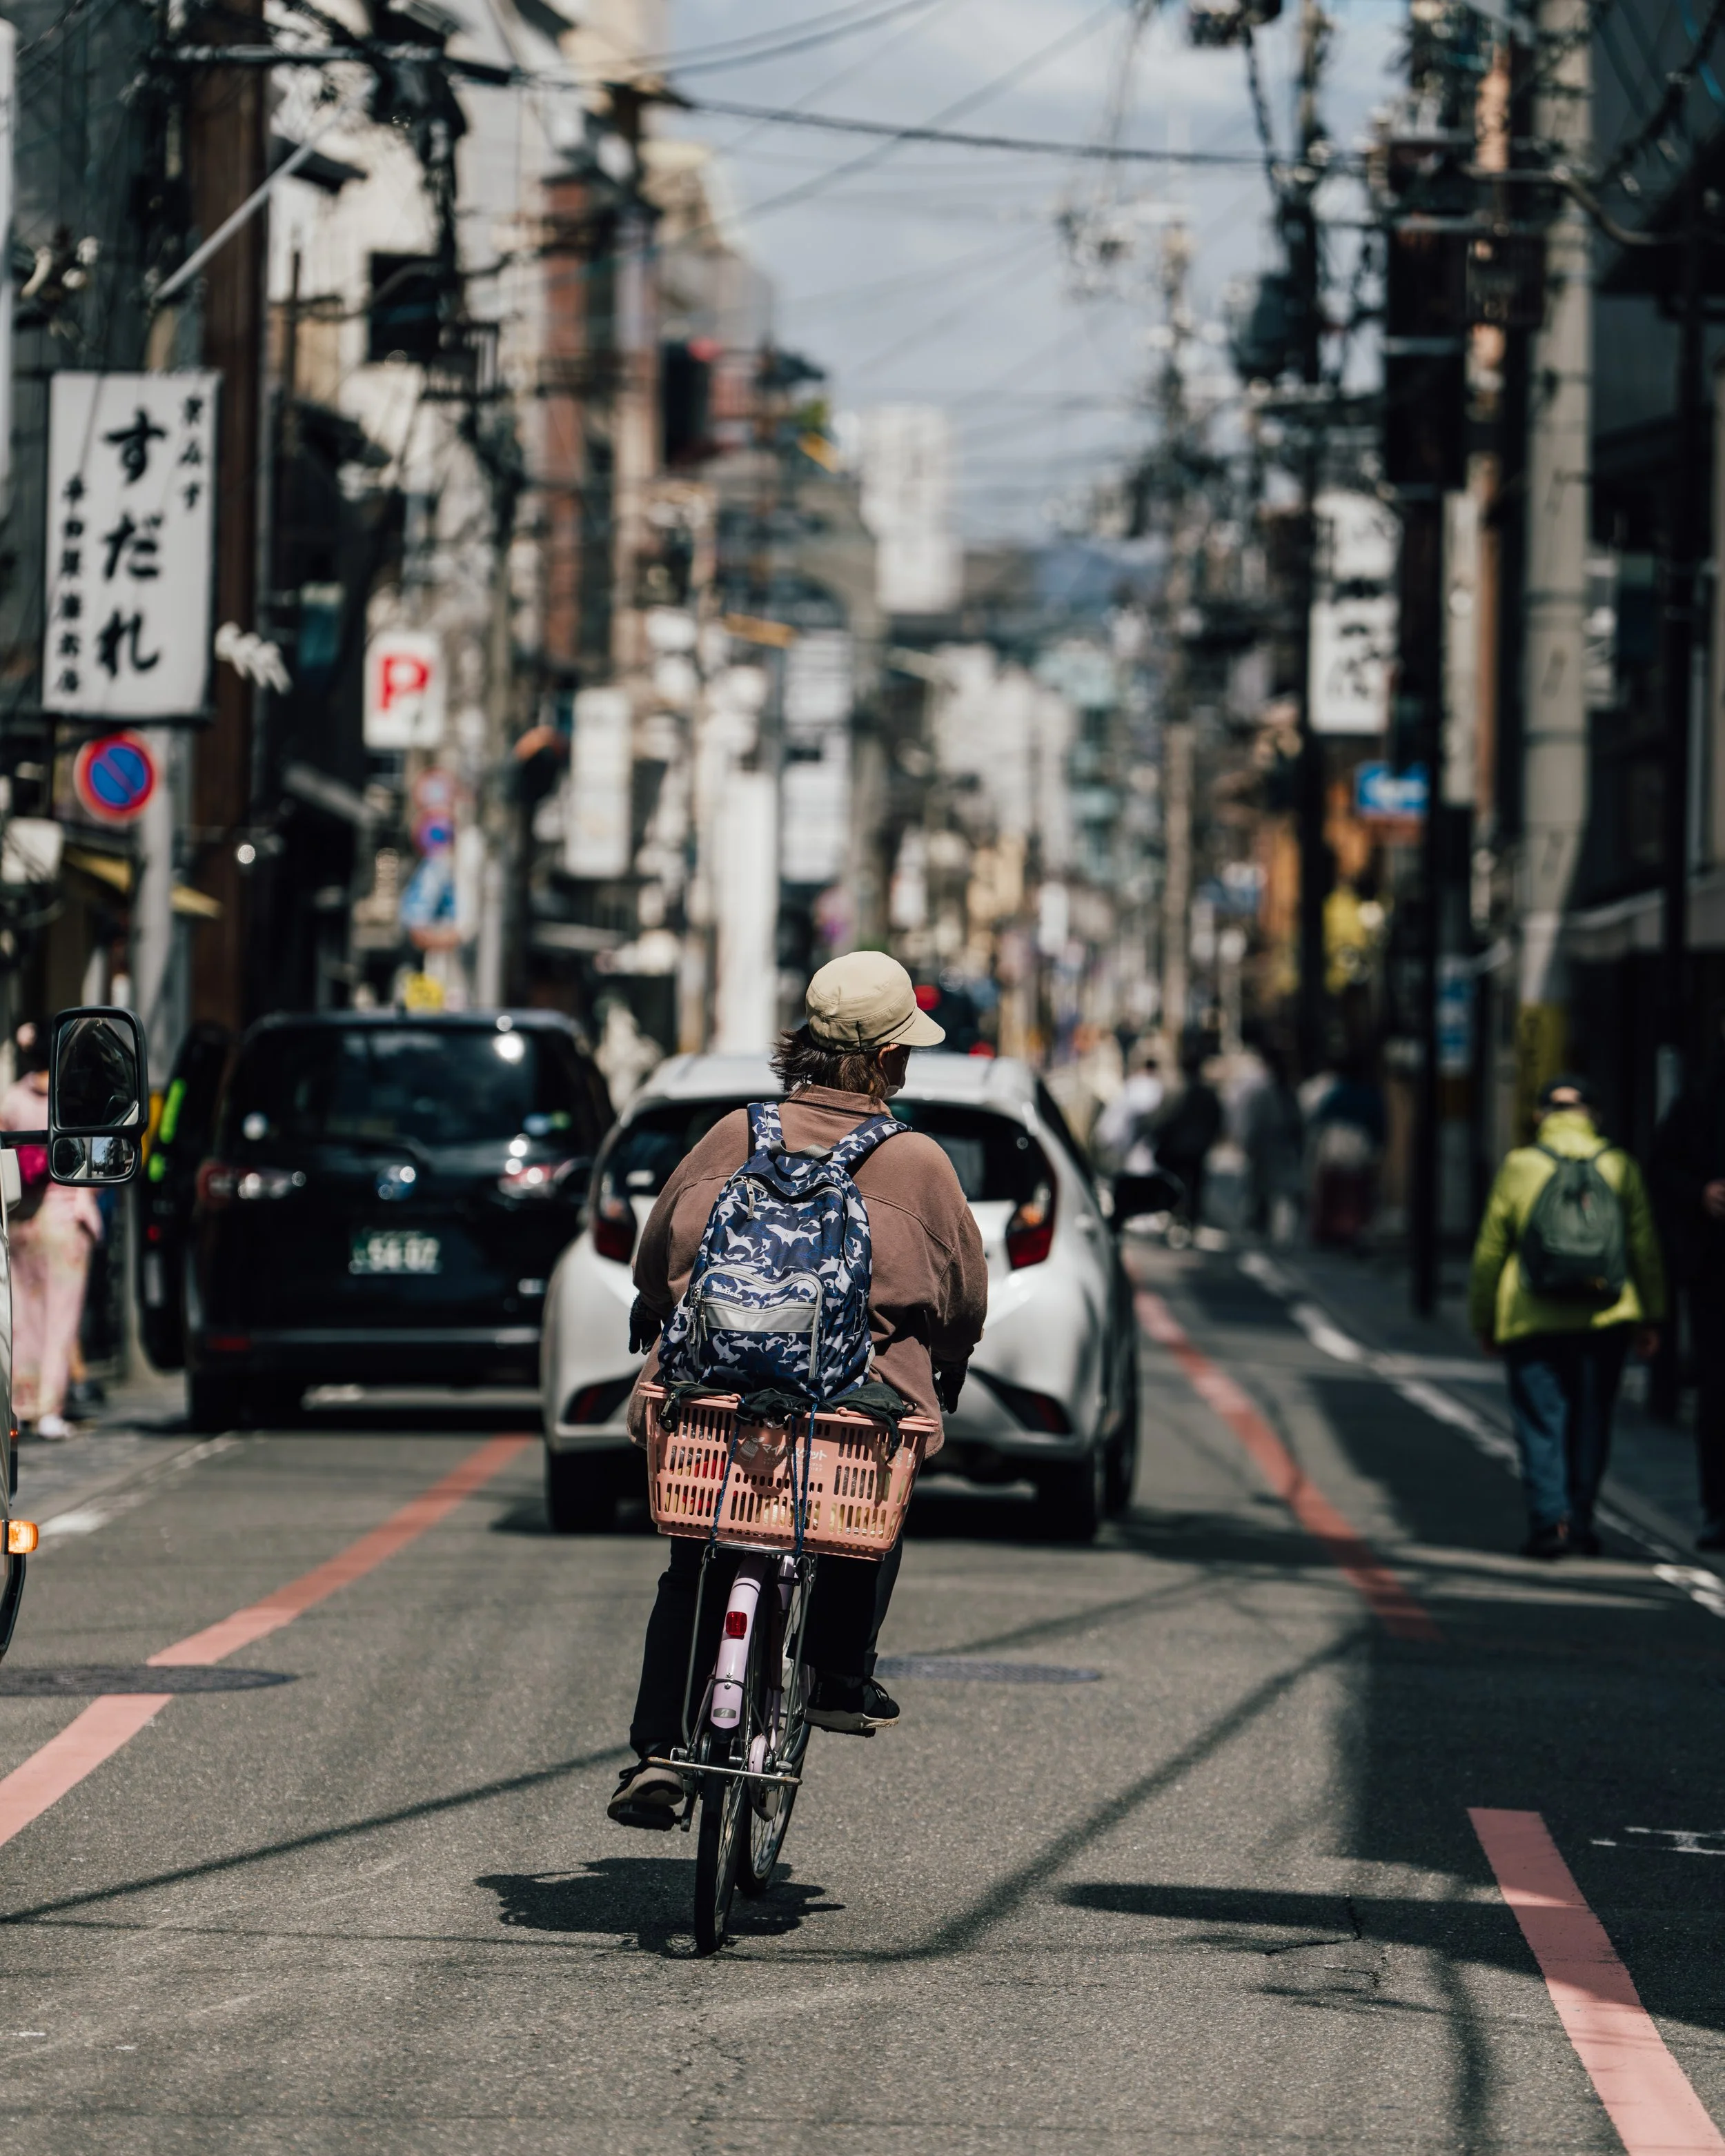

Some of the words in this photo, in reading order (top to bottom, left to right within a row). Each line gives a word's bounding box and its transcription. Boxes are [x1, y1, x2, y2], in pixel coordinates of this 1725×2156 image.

[96, 406, 170, 681] すだれ
[378, 652, 431, 713] P
